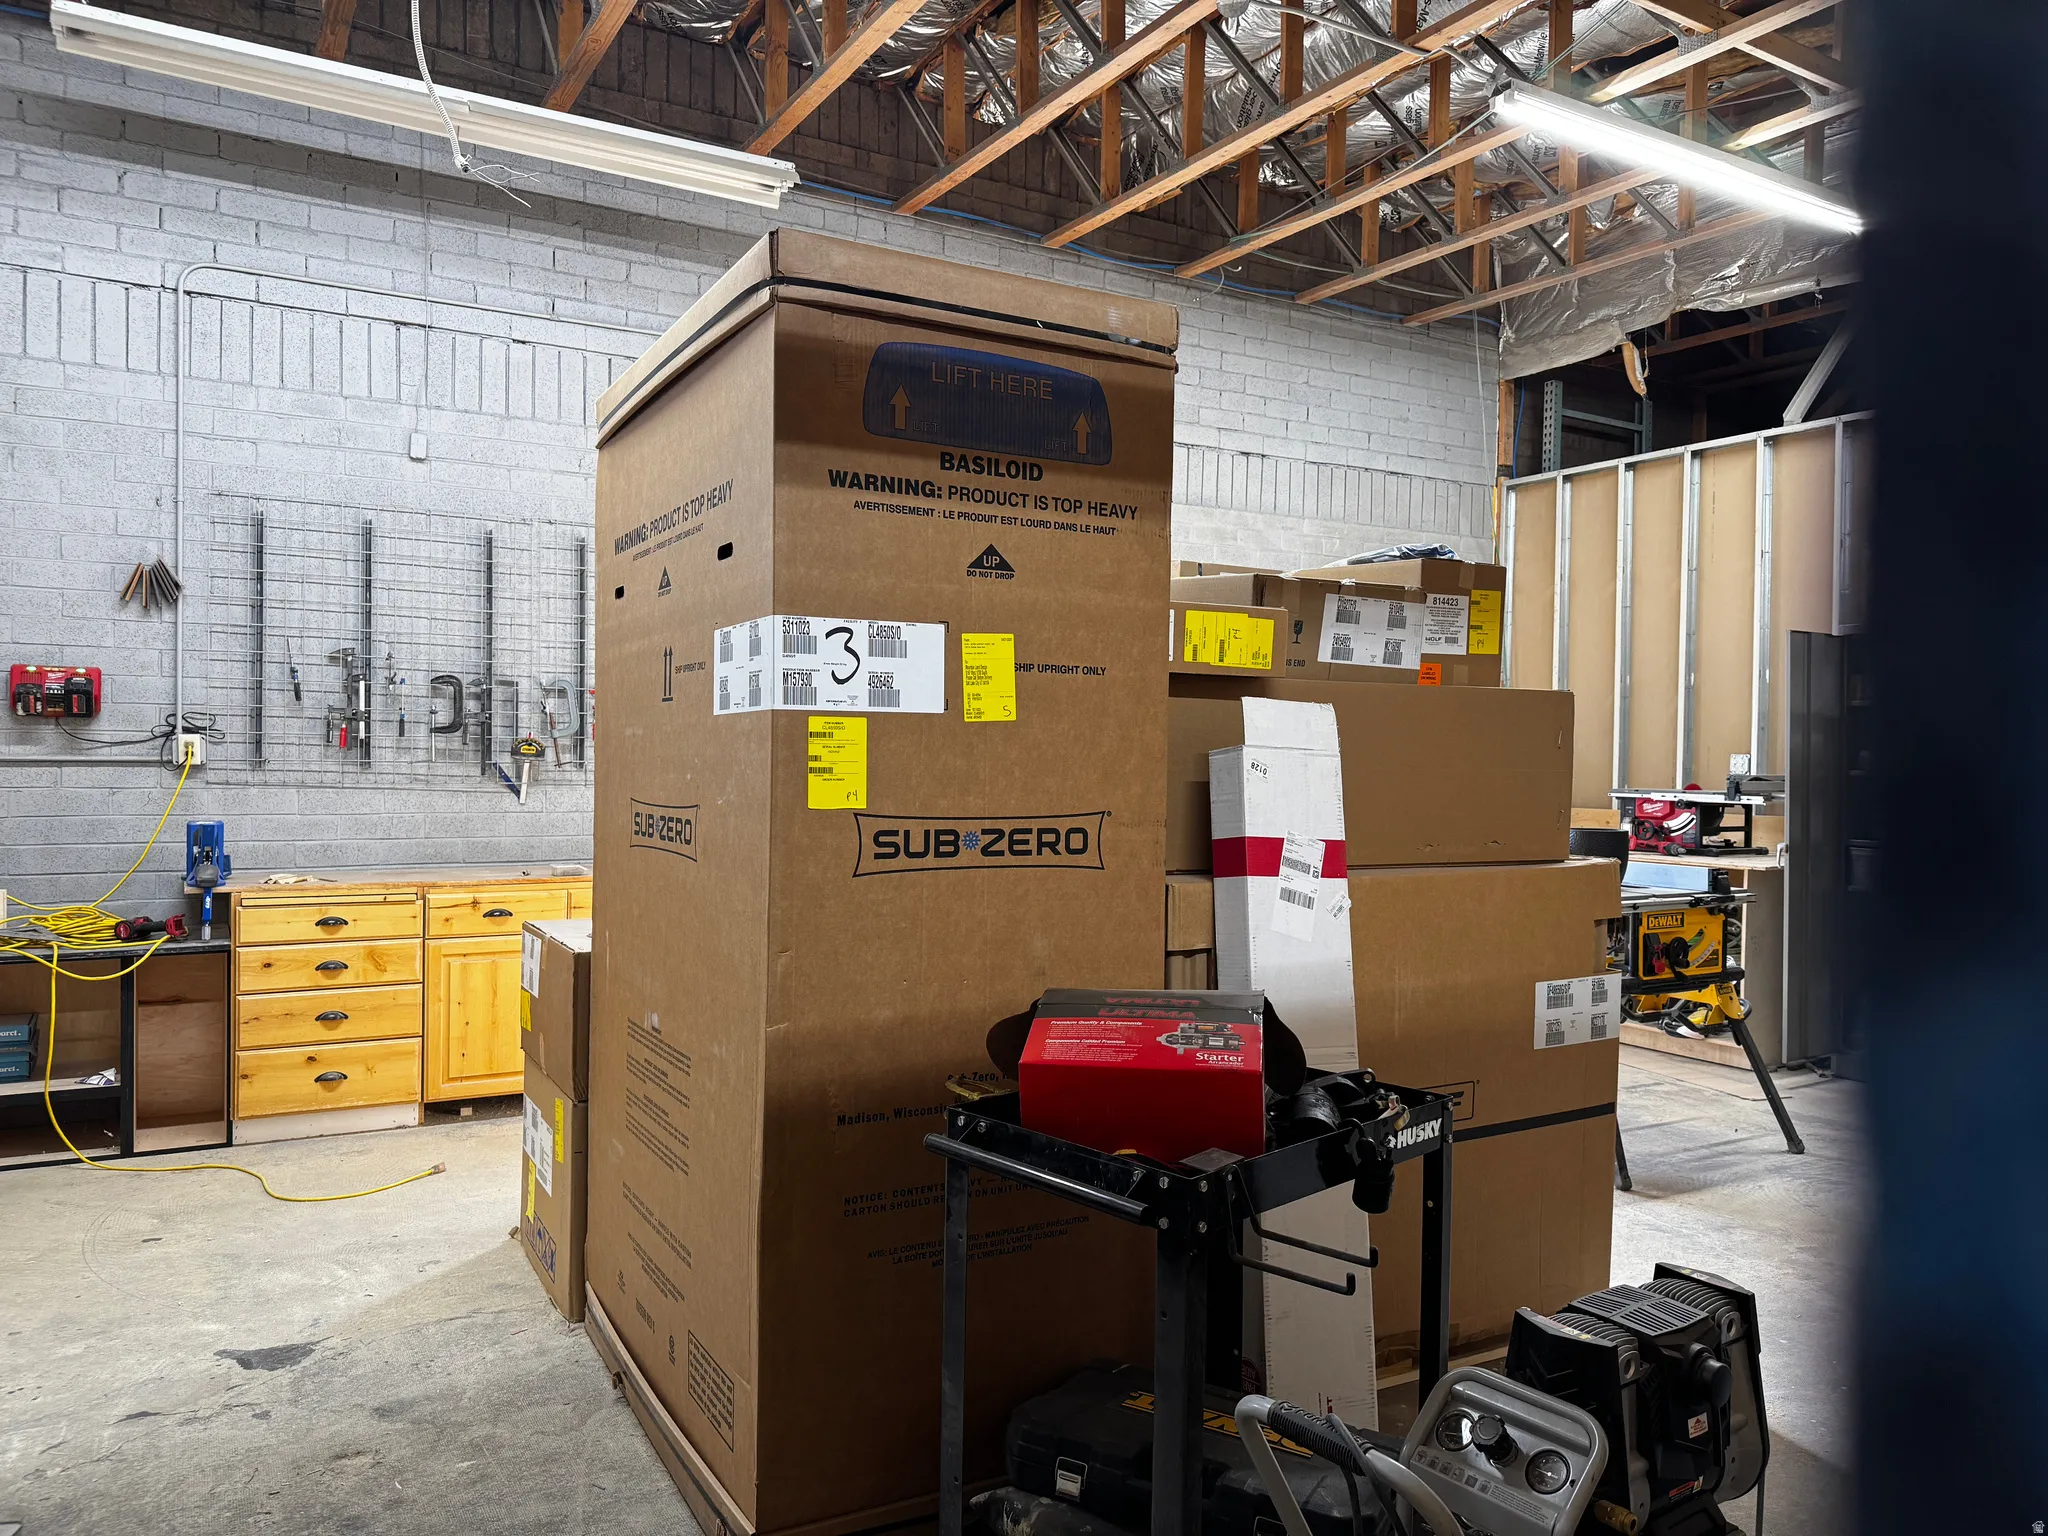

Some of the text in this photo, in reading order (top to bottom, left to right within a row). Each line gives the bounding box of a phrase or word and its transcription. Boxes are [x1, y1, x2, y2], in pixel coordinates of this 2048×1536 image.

[1268, 62, 1281, 88] ohns
[931, 361, 1053, 400] LIFT HERE
[913, 420, 939, 433] LIFT
[940, 451, 1043, 481] BASILOID
[828, 468, 1138, 520] WARNING: PRODUCT IS TOP HEAVY
[614, 478, 733, 556] WARNING: PRODUCT IS TOP HEAVY
[853, 500, 935, 517] AVERTISSEMENT
[942, 510, 955, 520] LE
[957, 511, 999, 524] PRODUIT
[1000, 516, 1018, 527] EST
[1020, 517, 1051, 530] LOURD
[1054, 521, 1078, 533] DANS
[1080, 523, 1091, 534] LE
[1092, 525, 1116, 536] HAUT
[983, 555, 1000, 567] UP
[966, 570, 1014, 580] DO NOT DROP
[1432, 597, 1459, 606] 814423
[782, 619, 811, 635] 5311023
[825, 626, 861, 685] 3
[1293, 659, 1306, 667] END
[782, 671, 813, 687] M157930
[1014, 662, 1107, 676] SHIP UPRIGHT ONLY
[634, 812, 692, 845] SUB ZERO
[873, 827, 1088, 860] SUB ZERO
[1098, 1009, 1198, 1019] ULTIMA
[1195, 1052, 1245, 1062] Starter
[837, 1112, 890, 1127] Madison,
[1397, 1118, 1442, 1149] HUSKY
[844, 1182, 945, 1206] NOTICE: CONTENTS
[844, 1203, 887, 1218] CARTON
[889, 1197, 930, 1211] SHOULD
[975, 1188, 988, 1198] ON
[990, 1184, 1013, 1195] UNIT
[868, 1249, 887, 1259] AVIS:
[888, 1247, 898, 1256] LE
[900, 1240, 937, 1253] CONTENU
[985, 1225, 1026, 1239] MANIPULEZ
[1026, 1222, 1046, 1233] AVEC
[892, 1257, 903, 1265] LA
[989, 1239, 1005, 1248] SUR
[1033, 1228, 1068, 1242] JUSQU'AU
